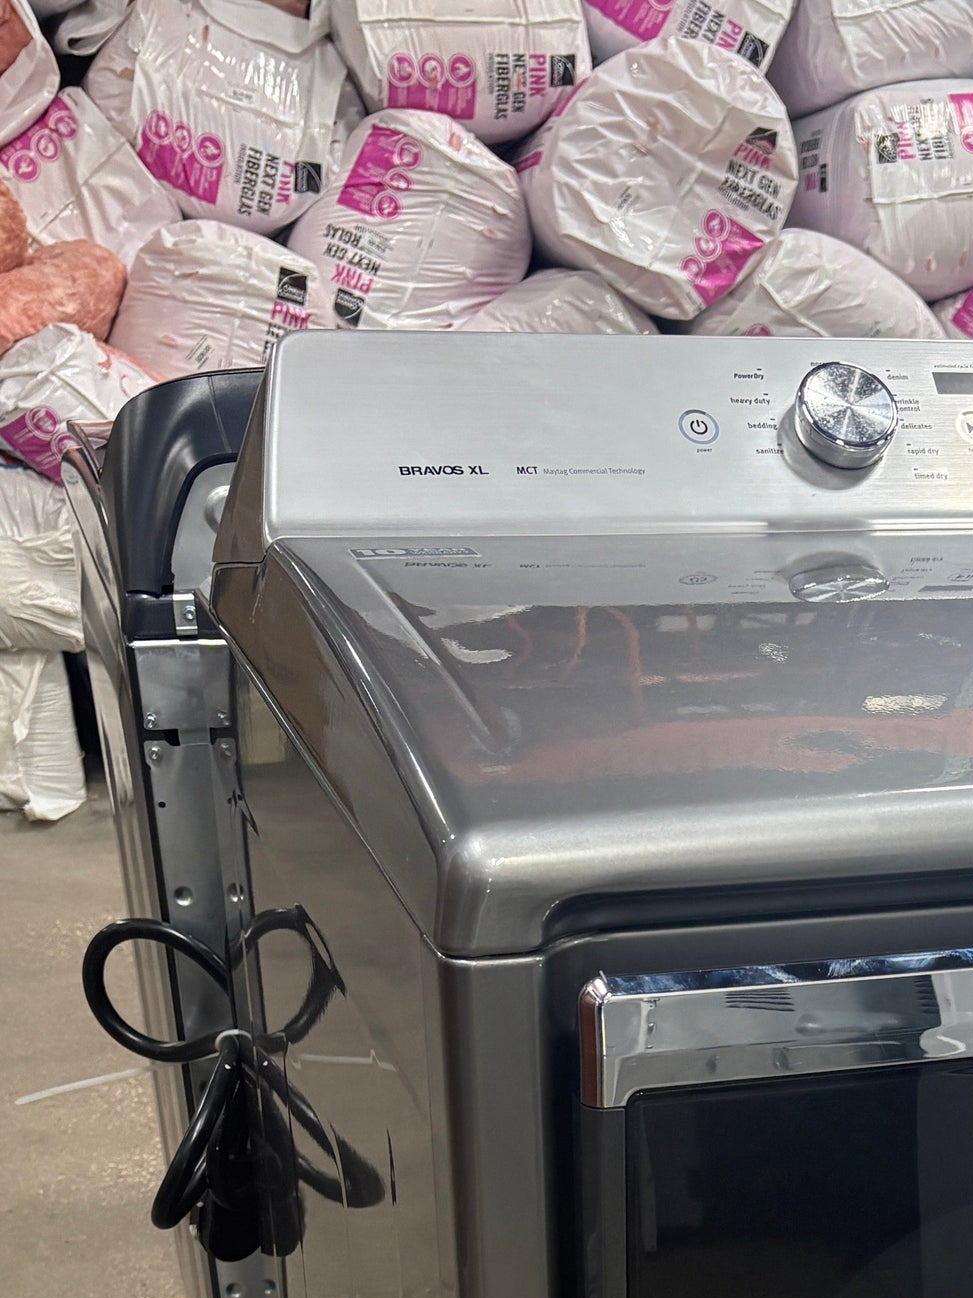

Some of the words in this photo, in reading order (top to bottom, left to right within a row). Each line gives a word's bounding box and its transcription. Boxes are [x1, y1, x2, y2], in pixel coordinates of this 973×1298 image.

[702, 10, 726, 44] NEXT
[716, 19, 743, 51] PIN
[494, 53, 511, 120] FIBERGLAS
[528, 53, 548, 98] PINK
[511, 91, 526, 113] GEN
[238, 146, 264, 217] FIBERGLAS
[261, 153, 280, 189] NEXT
[275, 160, 296, 206] PINK
[725, 158, 758, 185] NEXT
[256, 190, 274, 216] GEN
[347, 251, 382, 277] NEXT
[330, 263, 375, 297] PINK
[270, 300, 313, 329] PINK
[733, 372, 764, 380] PowerDry
[730, 397, 752, 405] heavy
[754, 397, 770, 405] duty
[747, 422, 778, 430] bedding
[900, 422, 933, 430] delicates
[756, 447, 784, 455] sanitize
[907, 447, 926, 455] rapid
[927, 447, 939, 455] dry
[399, 465, 465, 476] BRAVOS
[469, 465, 489, 475] XL
[516, 466, 539, 475] MCT
[543, 467, 569, 476] Maytag
[569, 467, 608, 475] Commercial
[608, 466, 646, 476] Technology
[914, 472, 935, 480] timed
[936, 472, 948, 481] dry
